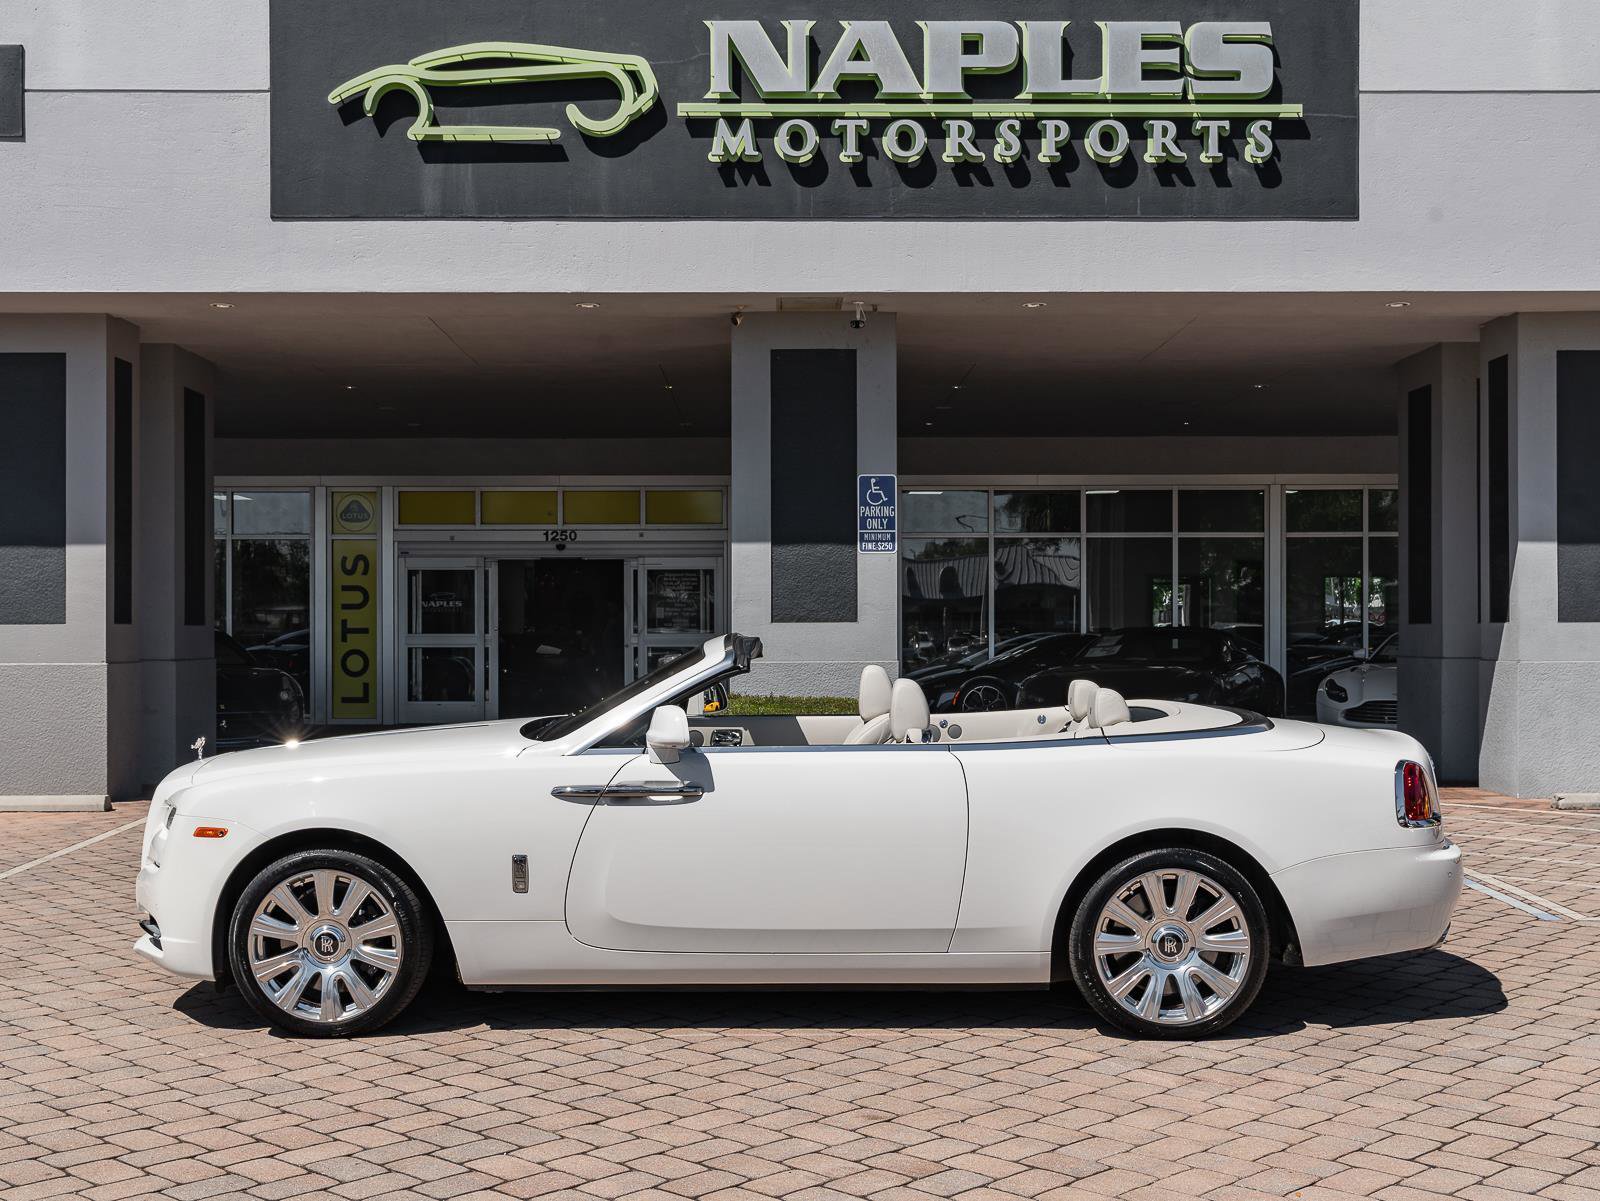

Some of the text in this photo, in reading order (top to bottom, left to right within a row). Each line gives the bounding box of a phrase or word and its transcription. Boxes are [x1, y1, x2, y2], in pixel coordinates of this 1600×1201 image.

[703, 20, 1274, 100] NAPLES
[707, 118, 1274, 163] MOTORSPORTS
[342, 512, 369, 520] LOTUS
[860, 506, 895, 517] PARKING
[866, 518, 888, 530] ONLY
[543, 530, 578, 541] 1250
[864, 533, 891, 541] MINIMUM
[422, 600, 463, 608] NAPLES
[340, 554, 370, 704] LOTUS
